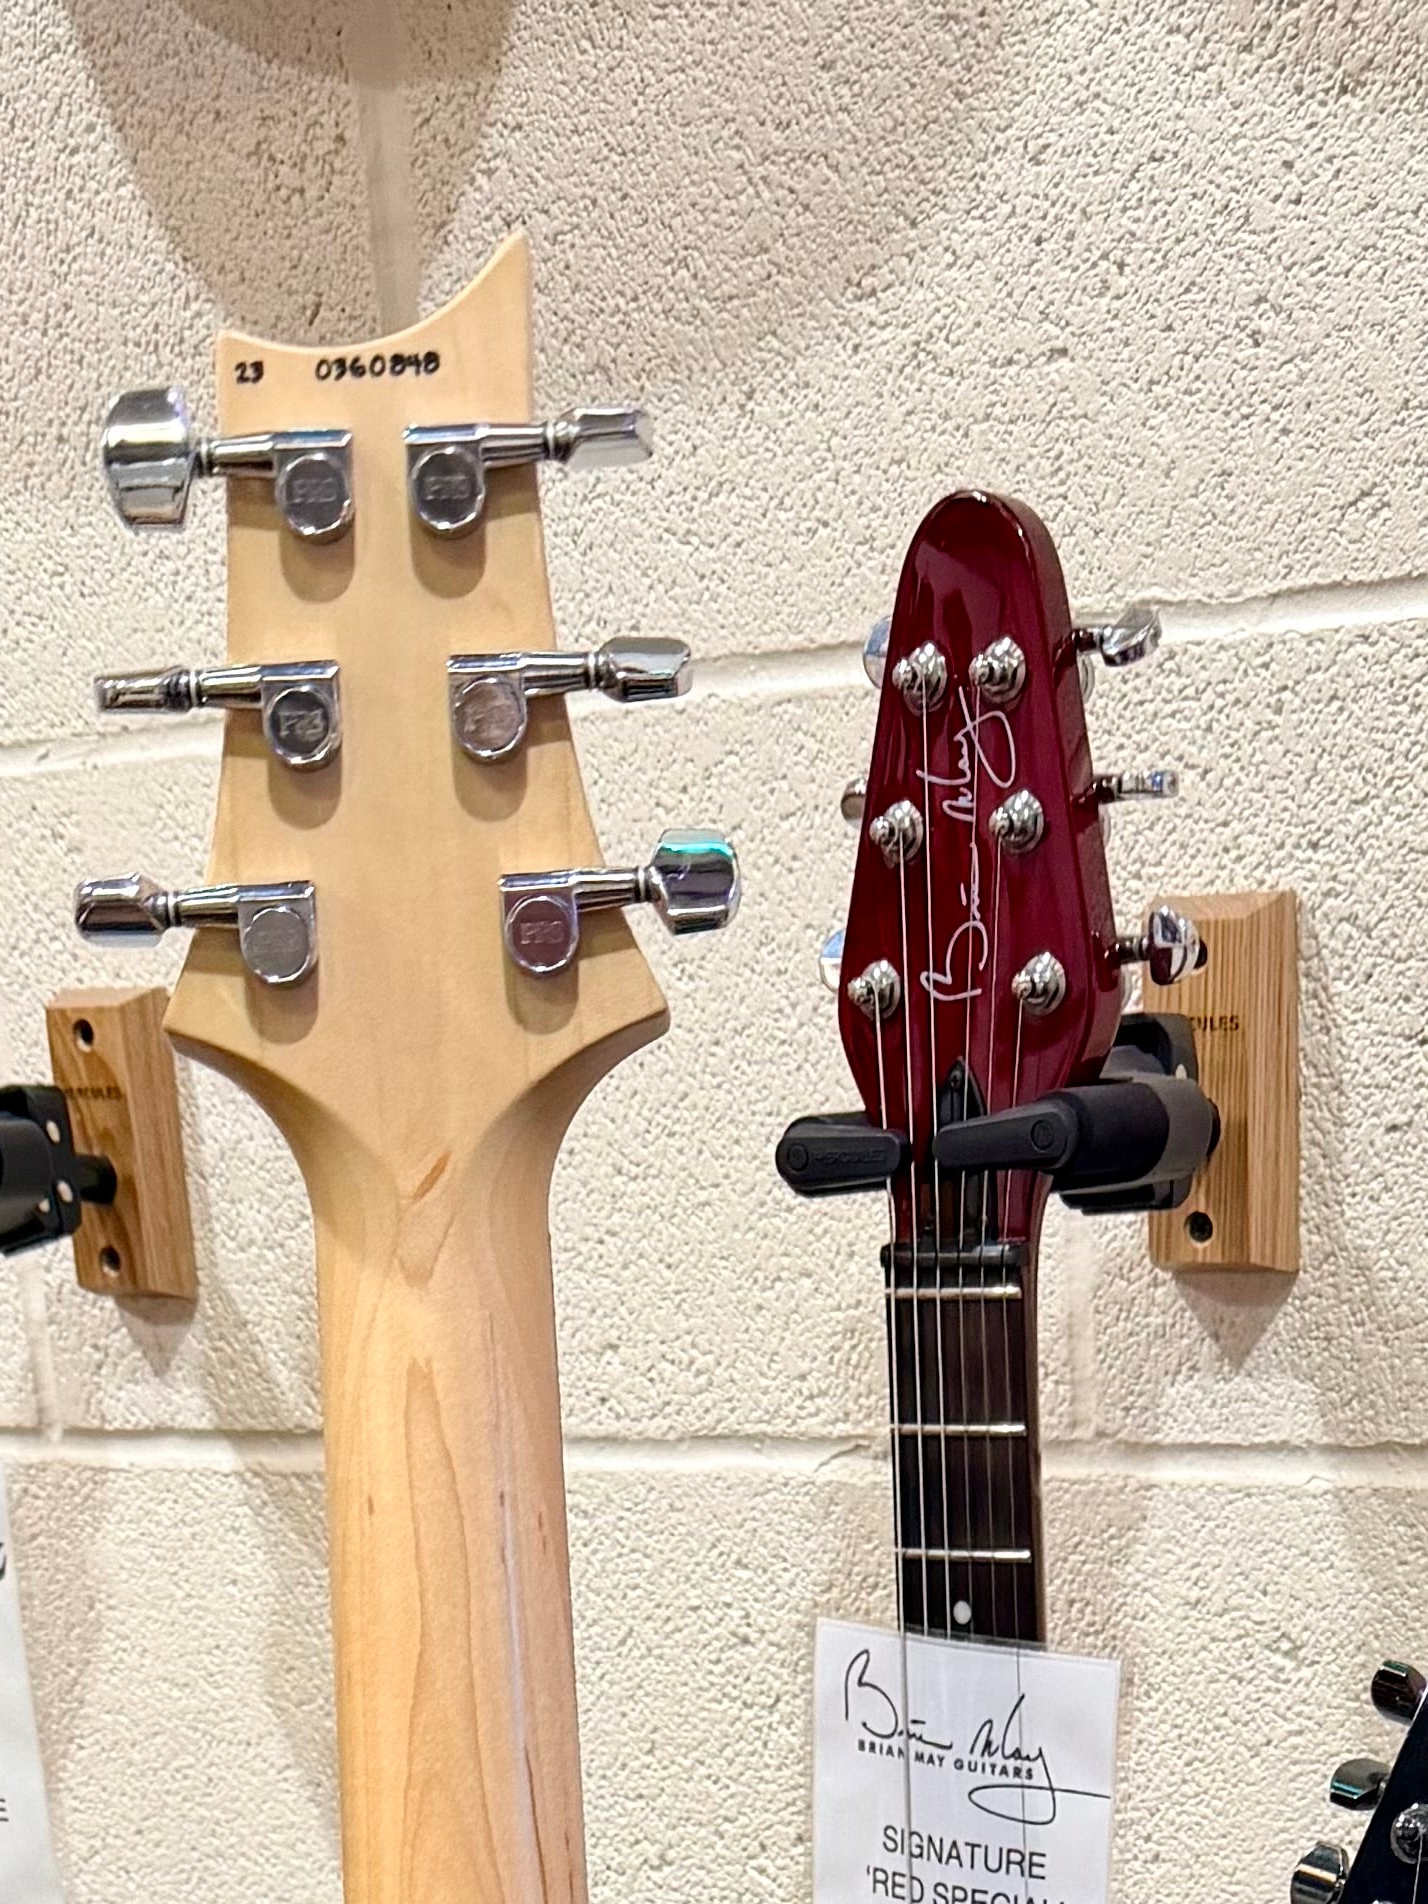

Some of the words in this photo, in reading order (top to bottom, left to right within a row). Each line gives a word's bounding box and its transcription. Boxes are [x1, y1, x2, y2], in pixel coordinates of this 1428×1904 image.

[234, 360, 264, 384] 23
[315, 351, 440, 382] 0360848
[858, 1738, 906, 1759] BRIAN
[914, 1751, 946, 1768] MAY
[953, 1758, 1035, 1782] GUITARS
[882, 1824, 1047, 1881] SIGNATURE
